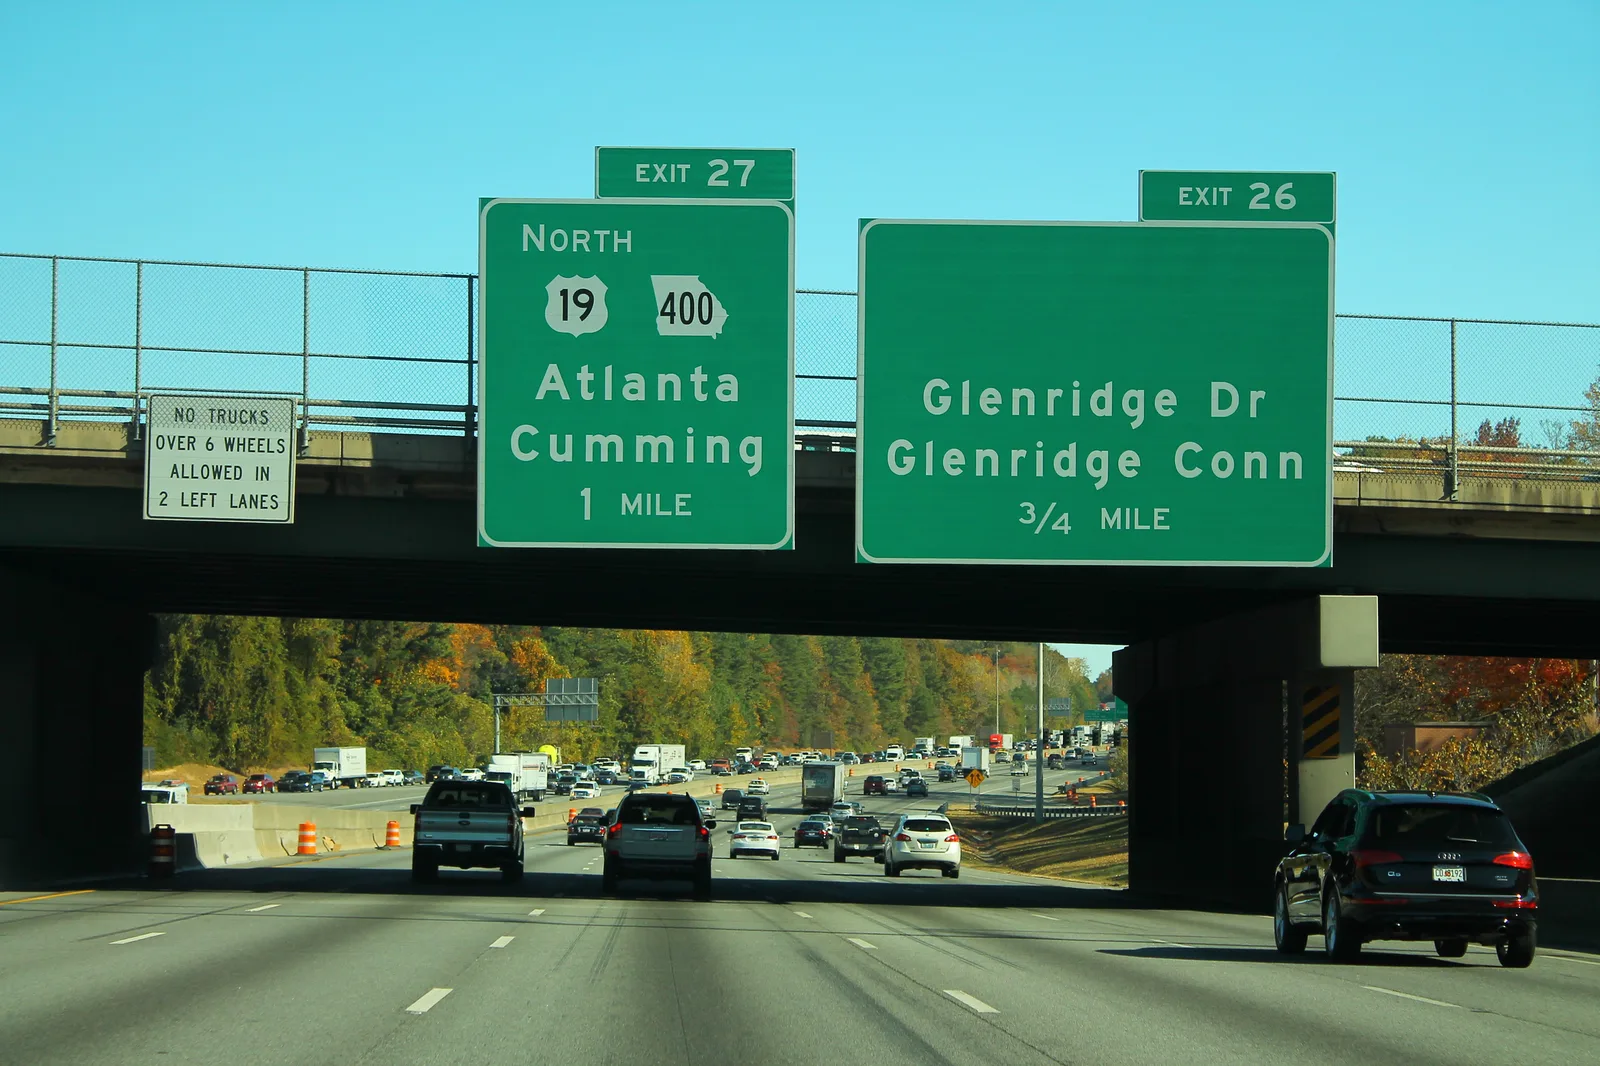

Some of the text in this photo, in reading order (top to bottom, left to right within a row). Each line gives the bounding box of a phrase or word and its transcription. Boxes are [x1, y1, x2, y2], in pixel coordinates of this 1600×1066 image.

[635, 158, 756, 188] EXIT 27
[1178, 182, 1297, 211] EXIT 26
[521, 223, 633, 253] NORTH
[558, 287, 596, 323] 19
[658, 290, 715, 326] 400
[535, 363, 740, 403] Atlanta
[174, 406, 270, 426] NO TRUCKS
[922, 377, 1267, 430] Glenridge Dr
[155, 434, 286, 455] OVER 6 WHEELS
[510, 423, 764, 478] Cumming
[170, 463, 271, 483] ALLOWED IN
[886, 438, 1304, 491] Glenridge Conn
[158, 490, 280, 511] 2 LEFT LANES
[580, 487, 693, 521] 1 MILE
[1100, 506, 1171, 531] MILE
